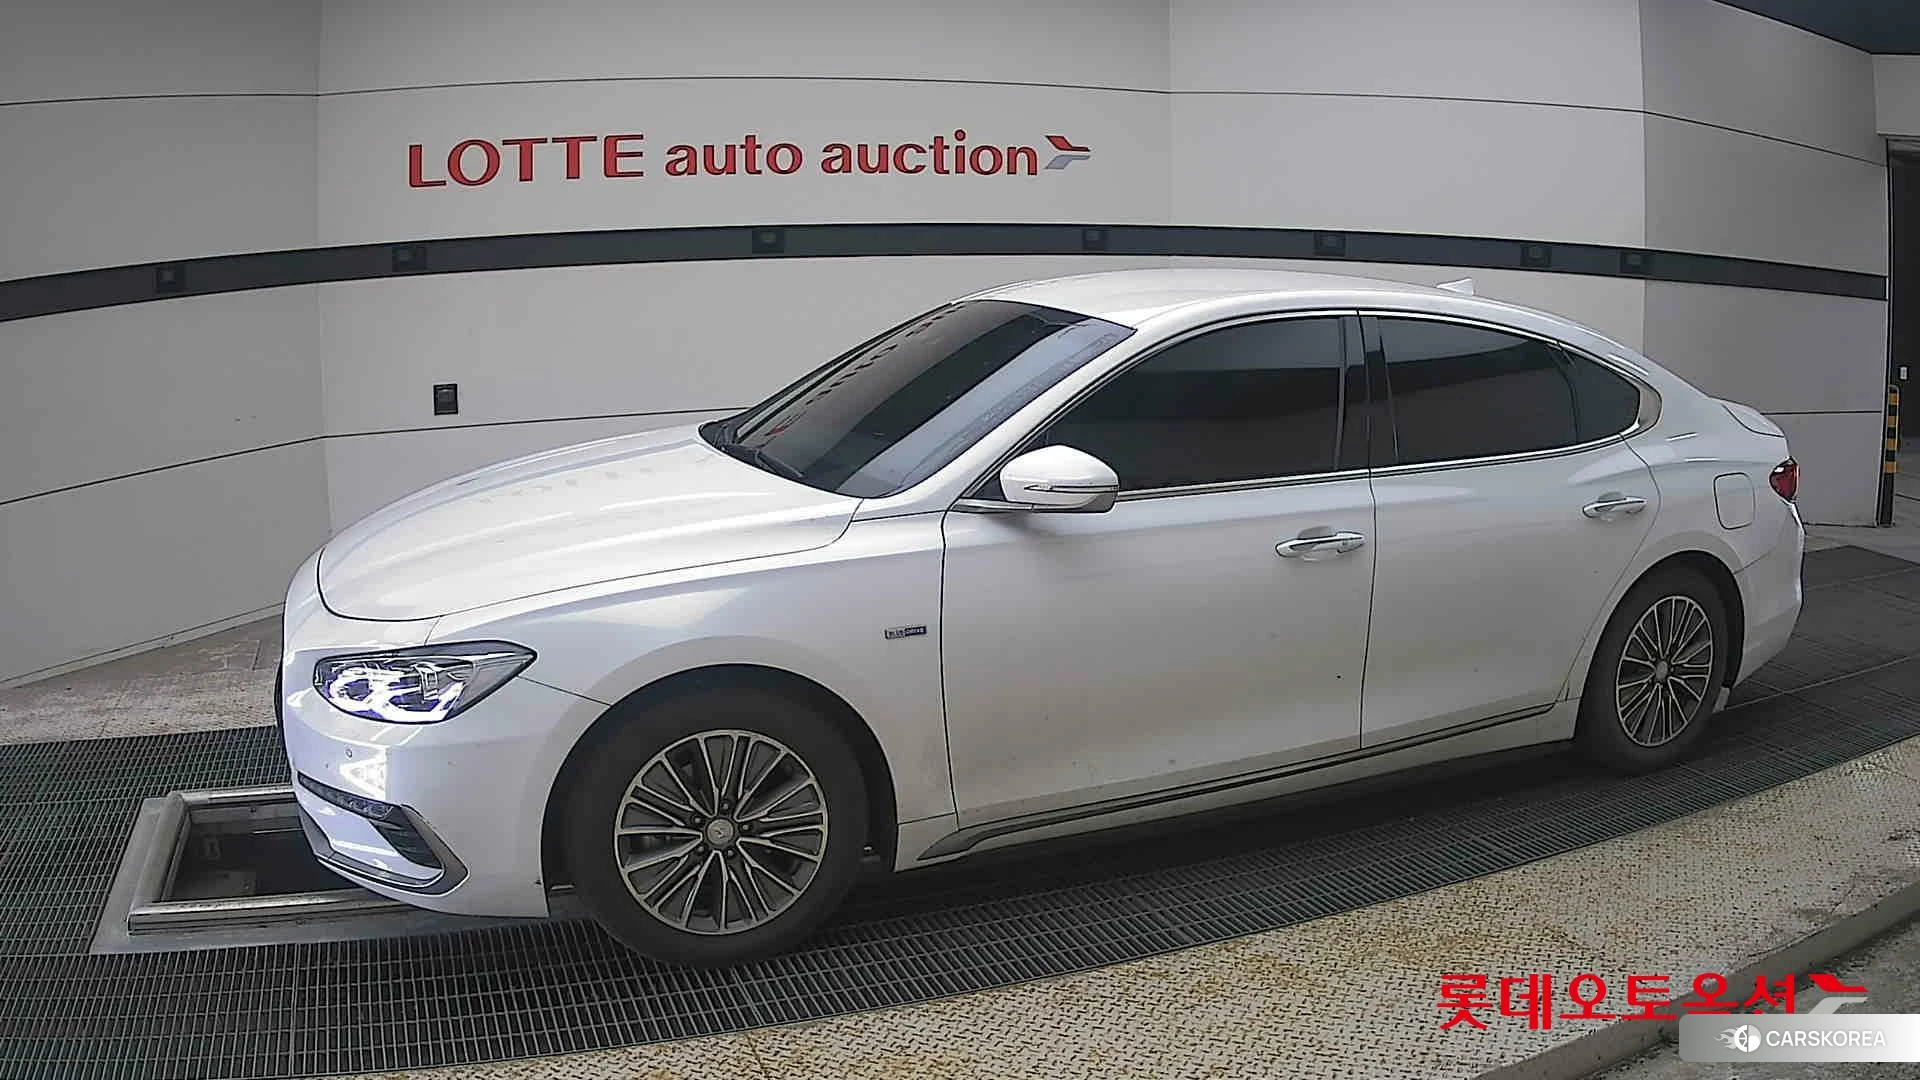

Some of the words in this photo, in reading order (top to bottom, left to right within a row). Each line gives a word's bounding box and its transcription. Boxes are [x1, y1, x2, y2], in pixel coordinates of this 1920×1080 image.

[408, 134, 644, 188] LOTTE
[664, 135, 803, 176] auto
[821, 129, 1039, 176] auction
